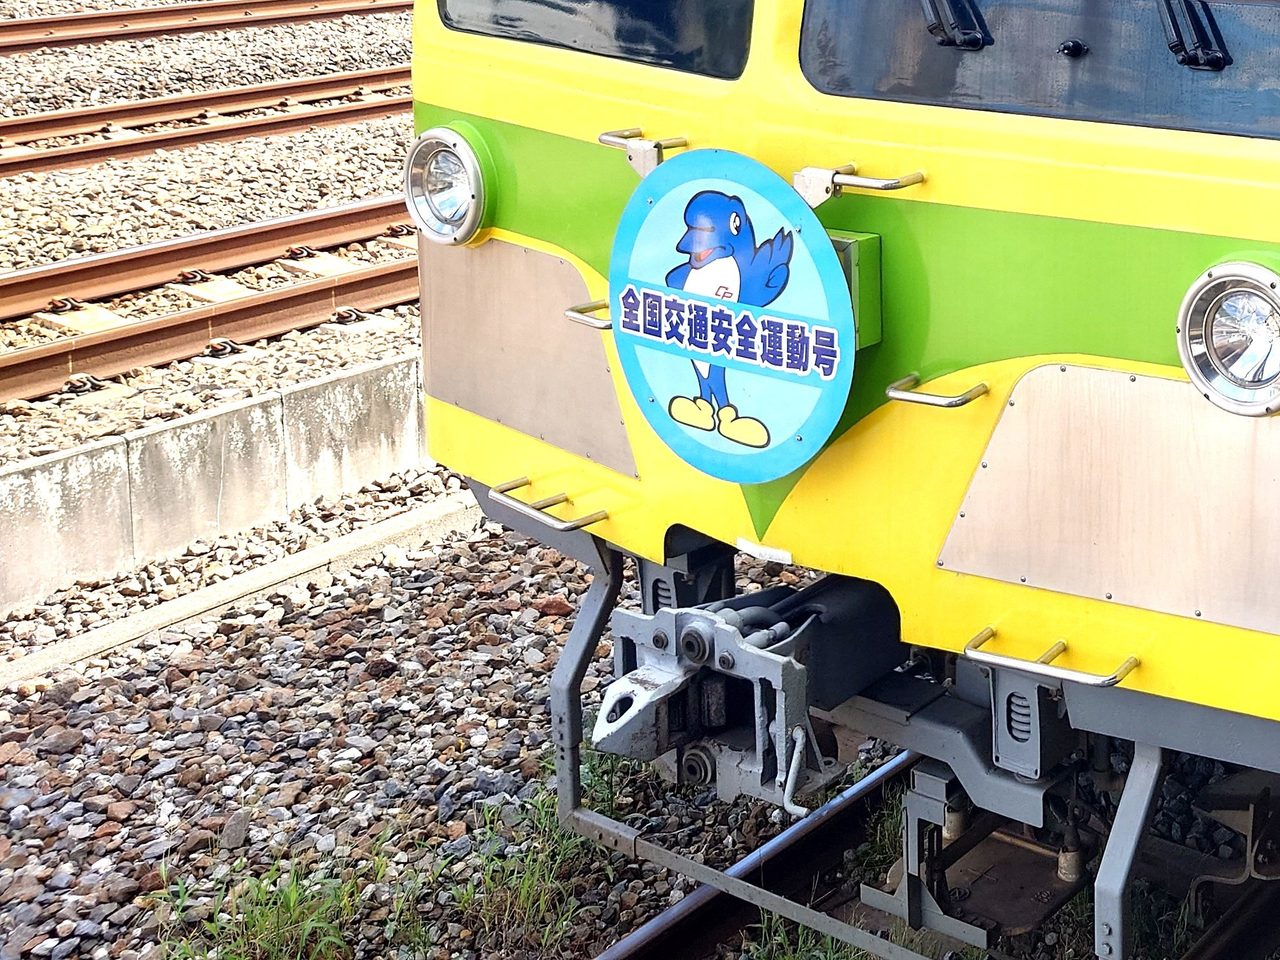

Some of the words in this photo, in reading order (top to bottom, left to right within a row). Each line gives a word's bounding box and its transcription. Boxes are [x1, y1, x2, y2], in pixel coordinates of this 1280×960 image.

[621, 288, 838, 376] 全国交通安全運動号
